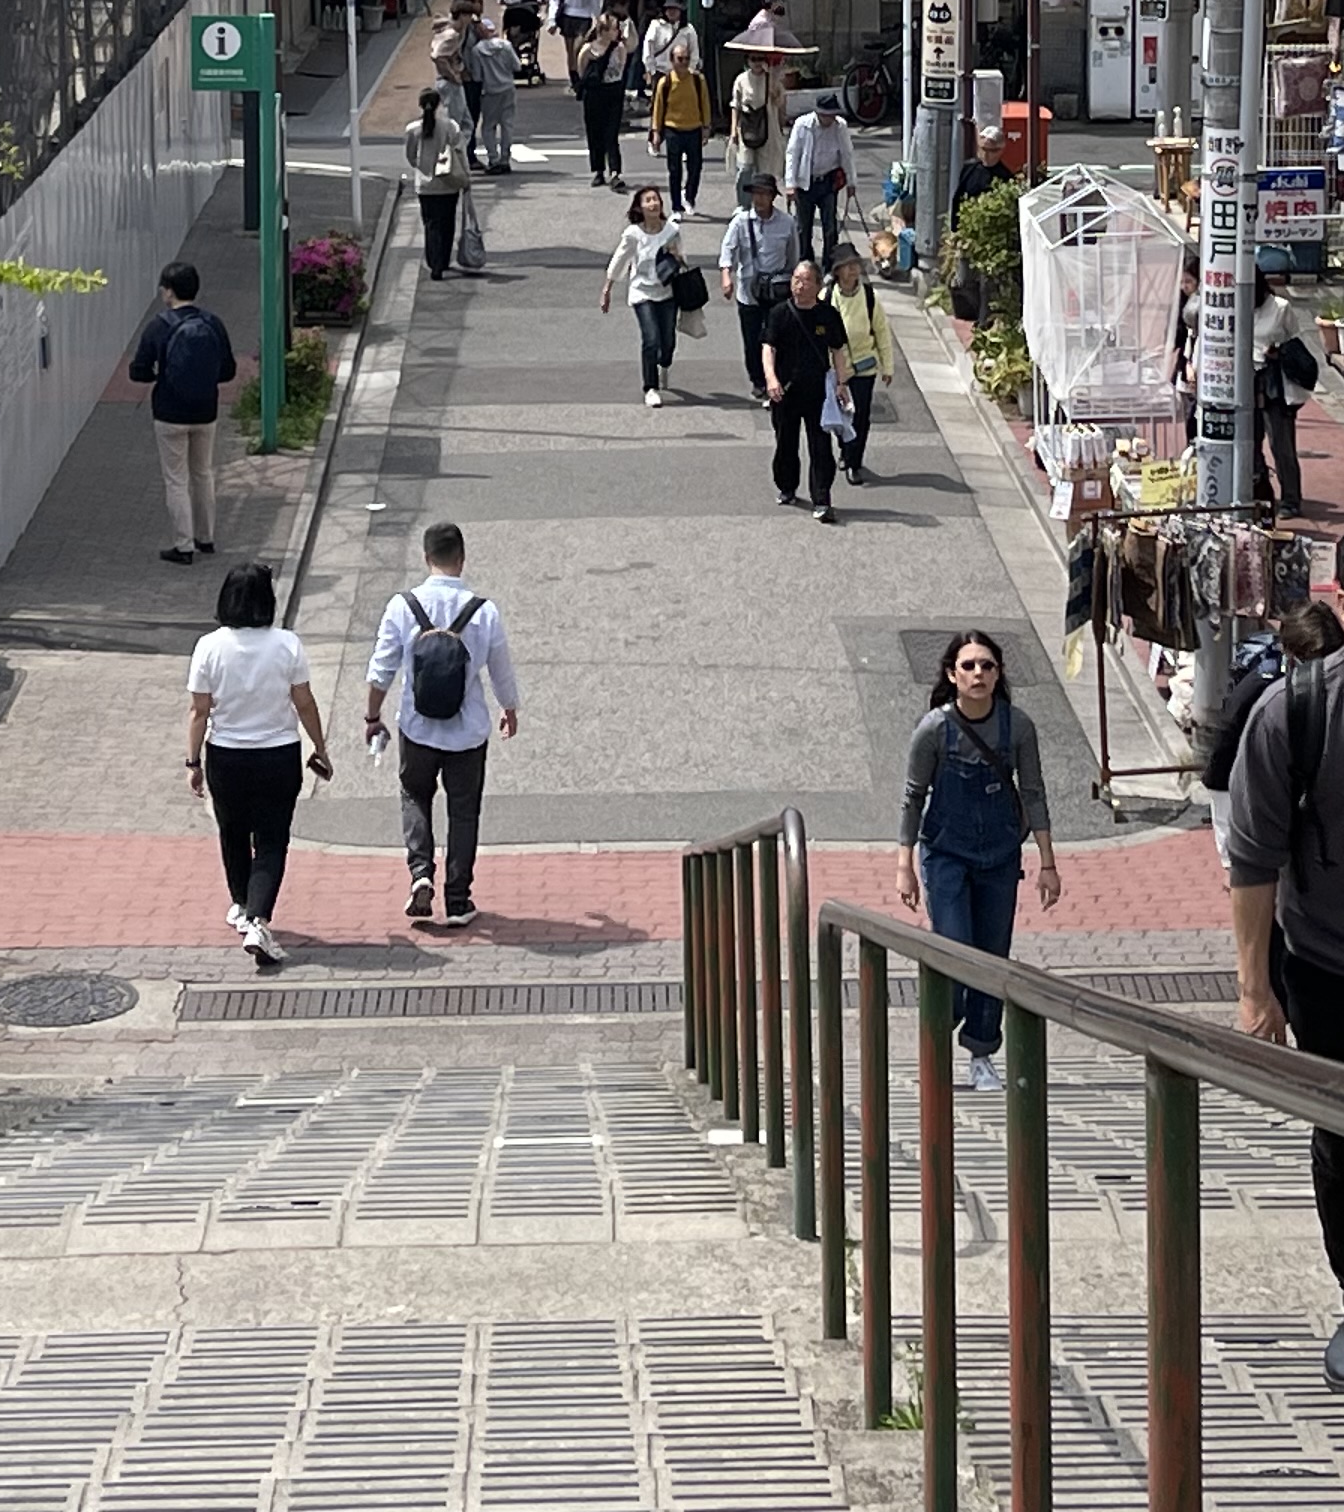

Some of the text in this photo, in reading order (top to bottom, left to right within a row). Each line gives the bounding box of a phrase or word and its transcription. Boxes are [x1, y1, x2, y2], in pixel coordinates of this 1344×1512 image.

[1270, 175, 1309, 189] Asahi
[1265, 199, 1317, 224] 焼肉
[1264, 228, 1318, 238] サラリーマン
